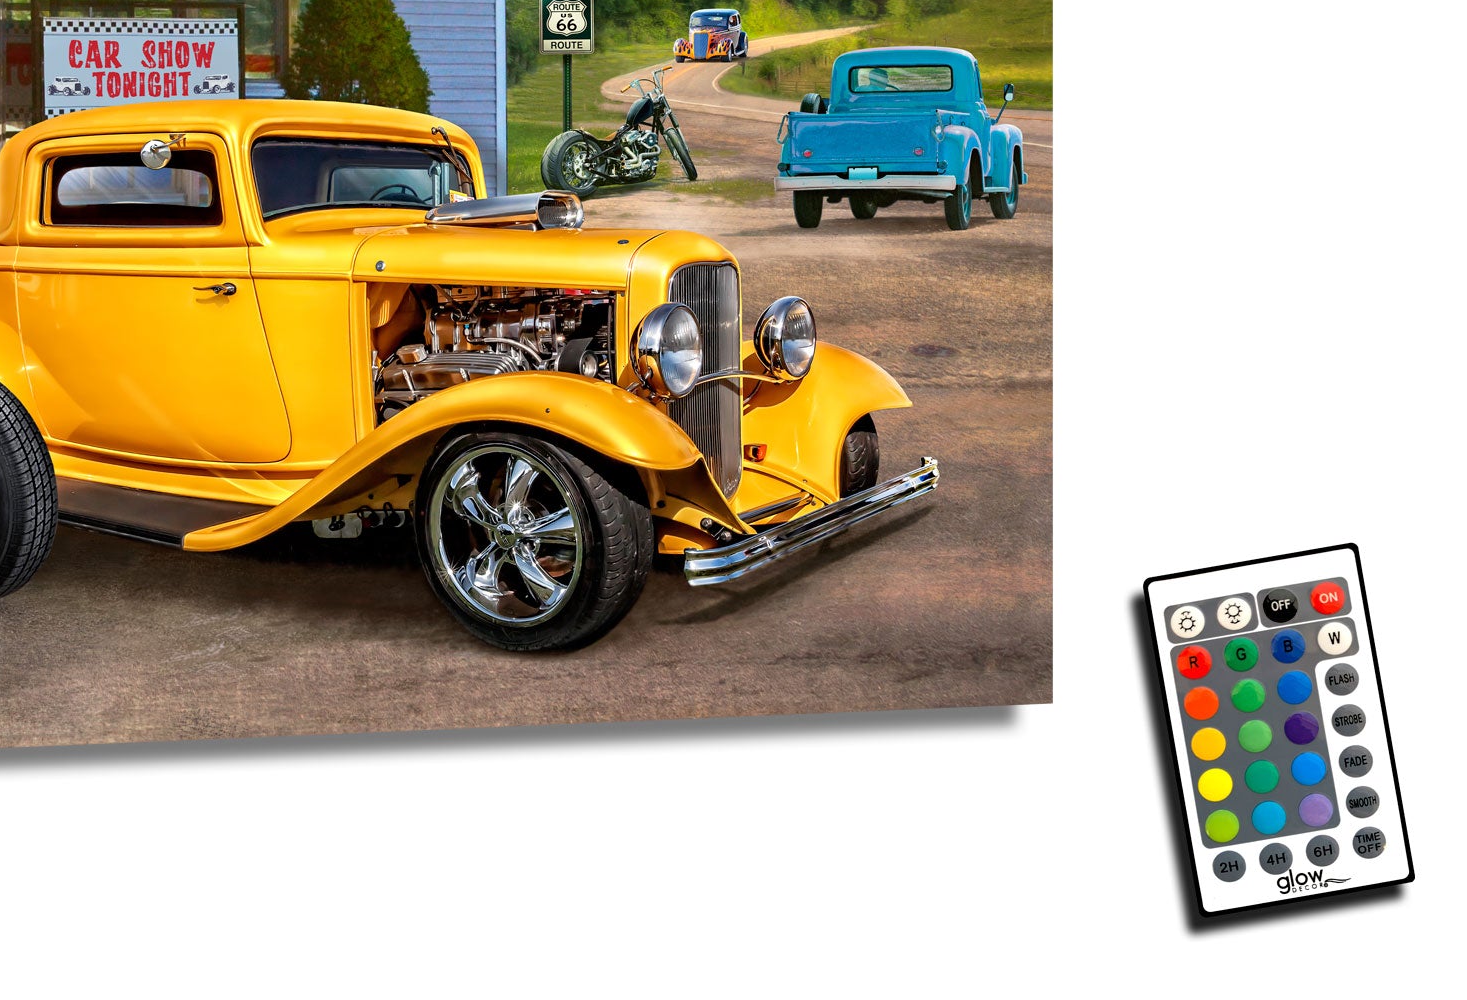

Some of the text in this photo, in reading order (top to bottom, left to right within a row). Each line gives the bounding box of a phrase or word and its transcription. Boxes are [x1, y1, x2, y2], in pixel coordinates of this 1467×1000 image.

[552, 3, 581, 11] ROUTE
[556, 18, 577, 31] 66
[550, 41, 583, 50] ROUTE
[68, 39, 215, 69] CAR SHOW
[92, 71, 191, 98] TONIGHT
[1319, 592, 1338, 604] ON
[1271, 599, 1291, 612] OFF
[1328, 631, 1341, 645] W
[1284, 640, 1293, 653] B
[1236, 648, 1247, 661] G
[1189, 656, 1198, 668] R
[1329, 673, 1355, 686] FLASH
[1334, 713, 1363, 727] STROBE
[1344, 755, 1368, 768] FADE
[1349, 796, 1377, 809] SMOOTH
[1355, 832, 1381, 844] TIME
[1313, 844, 1333, 858] 6H
[1357, 843, 1381, 854] OFF
[1266, 852, 1286, 866] 4H
[1219, 861, 1239, 873] 2H
[1277, 869, 1323, 894] glow
